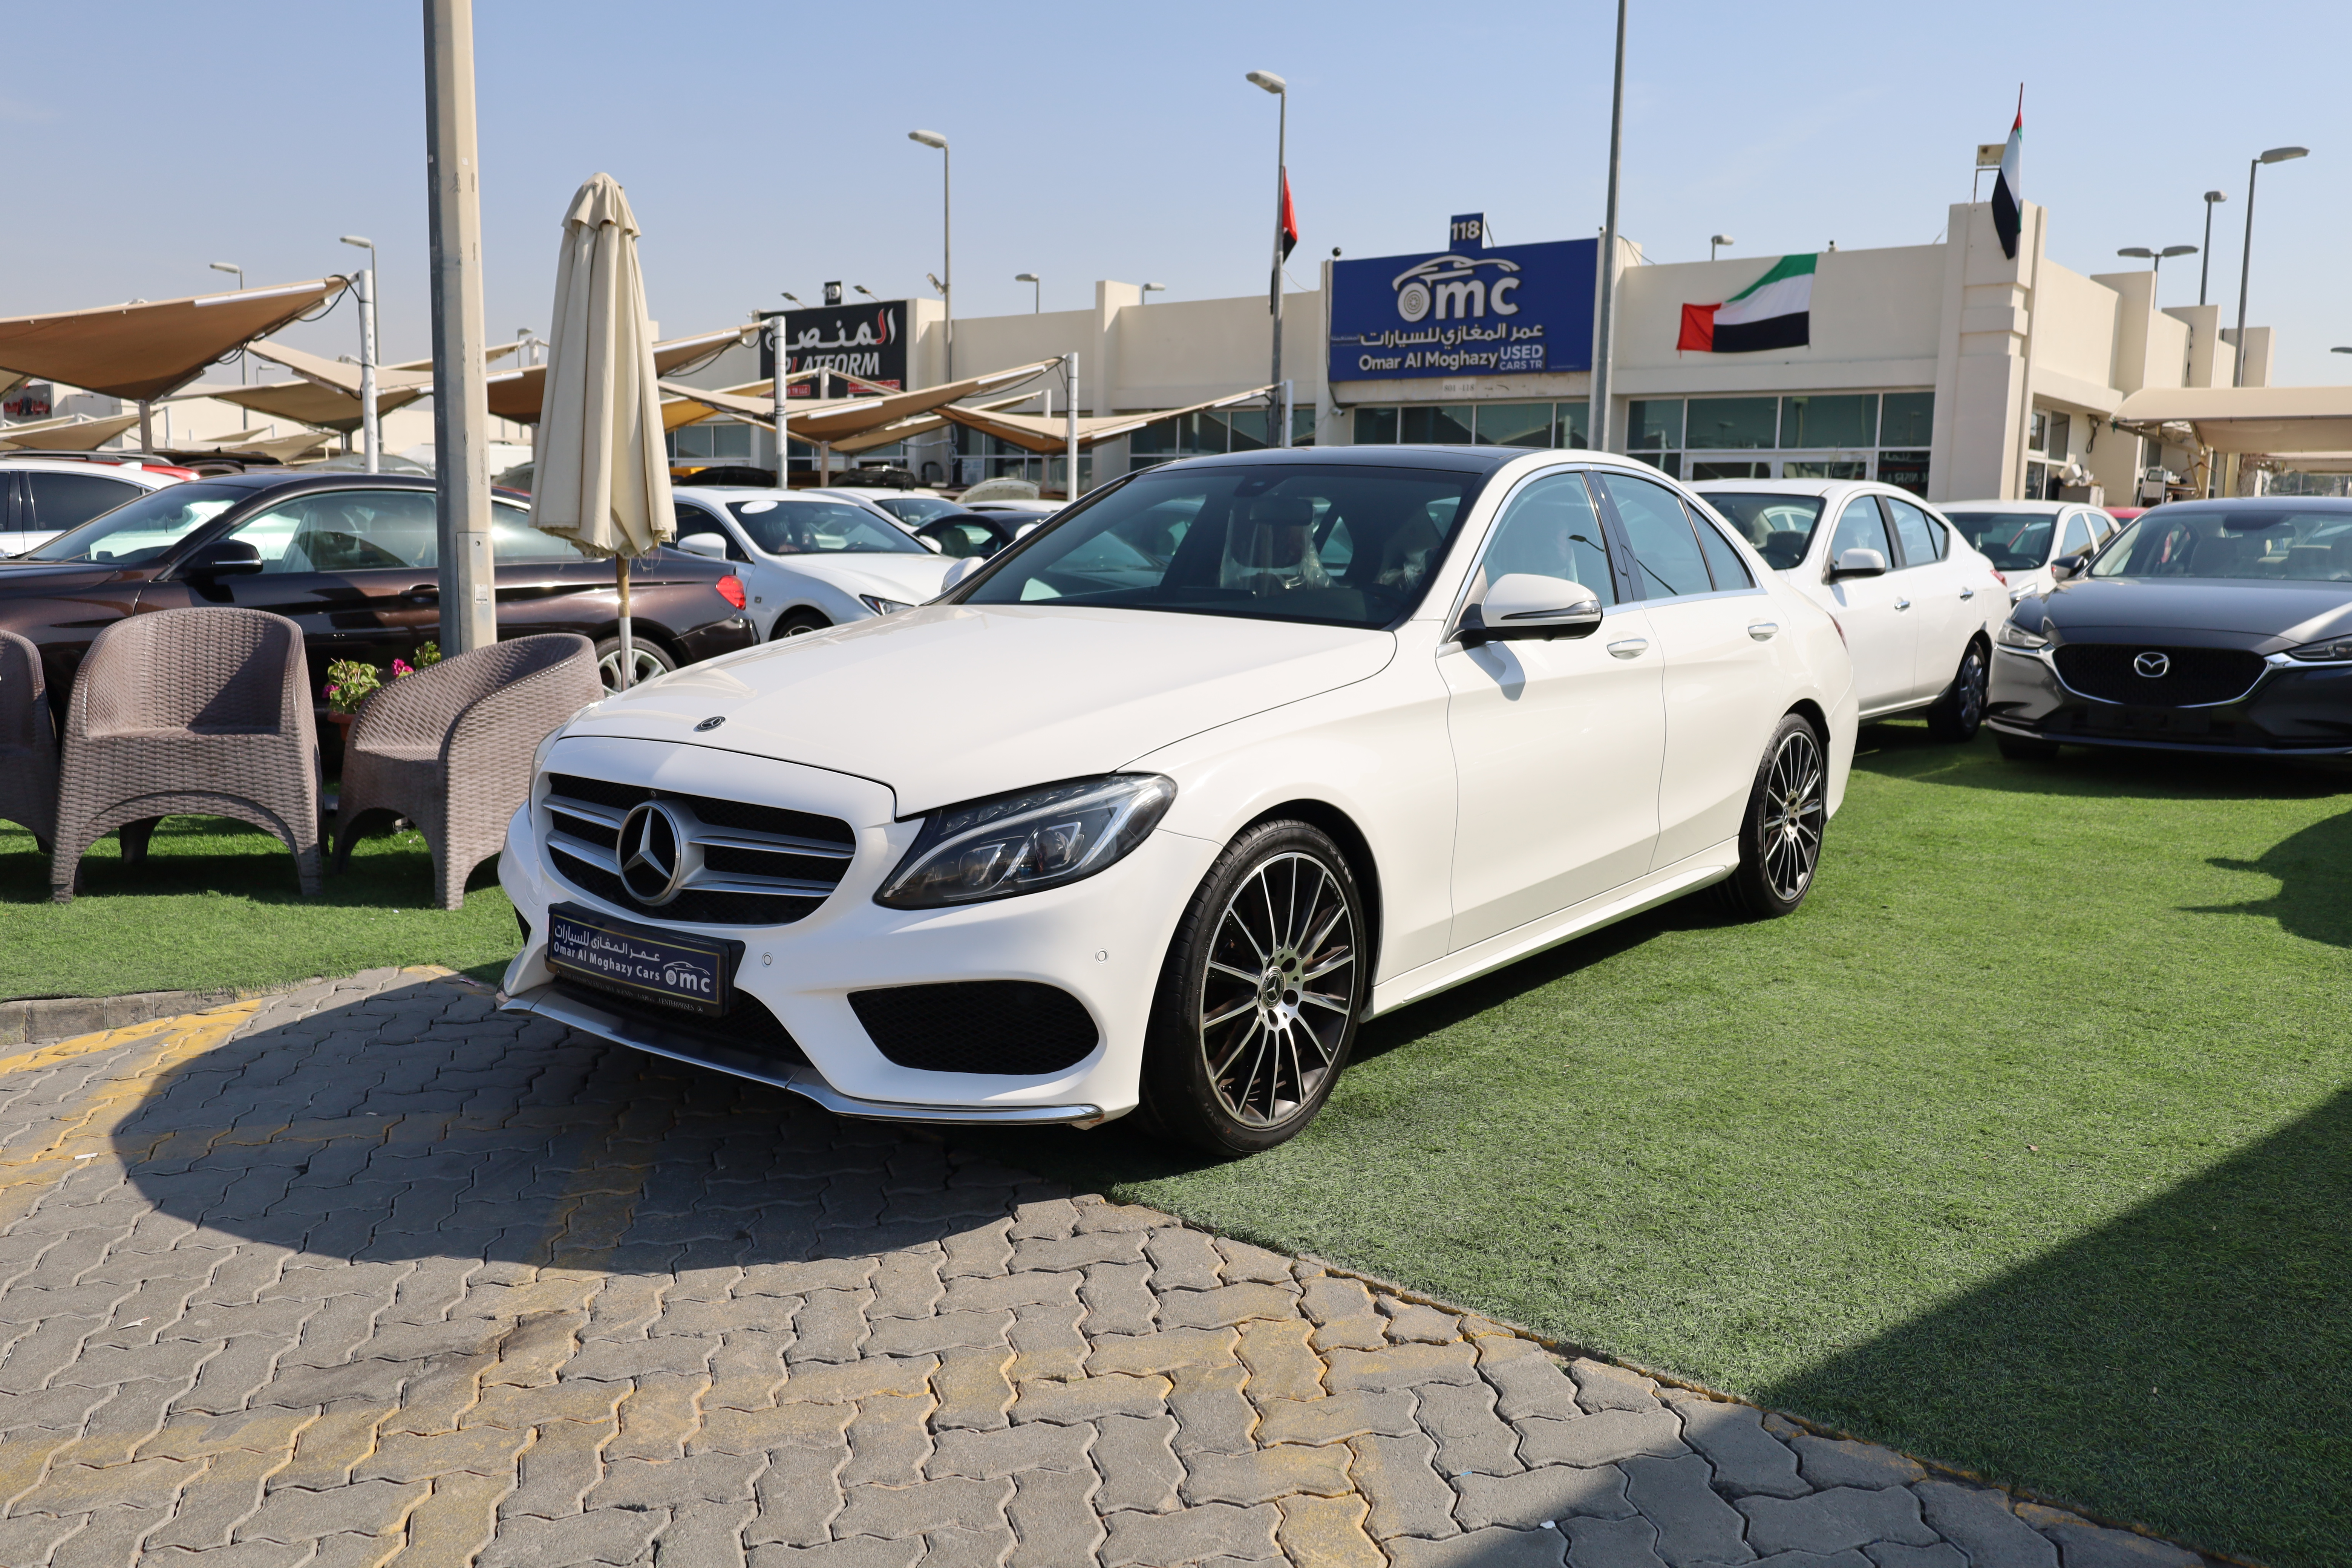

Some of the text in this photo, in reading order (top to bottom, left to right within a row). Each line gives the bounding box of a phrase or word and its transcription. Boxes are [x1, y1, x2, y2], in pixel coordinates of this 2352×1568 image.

[1451, 220, 1480, 240] 118
[1360, 322, 1543, 350] عمر المغازي للسيارات
[1359, 351, 1499, 371] Omar Al Moghazy
[1500, 345, 1543, 360] USED
[1500, 361, 1527, 371] CARS
[1530, 360, 1543, 369] TR
[639, 640, 660, 652] DUNLOP
[554, 924, 590, 946] للسيارات
[554, 941, 660, 981] Omar Al Moghazy Cars
[629, 945, 660, 962] عمر
[662, 998, 695, 1011] ENTERPRISES
